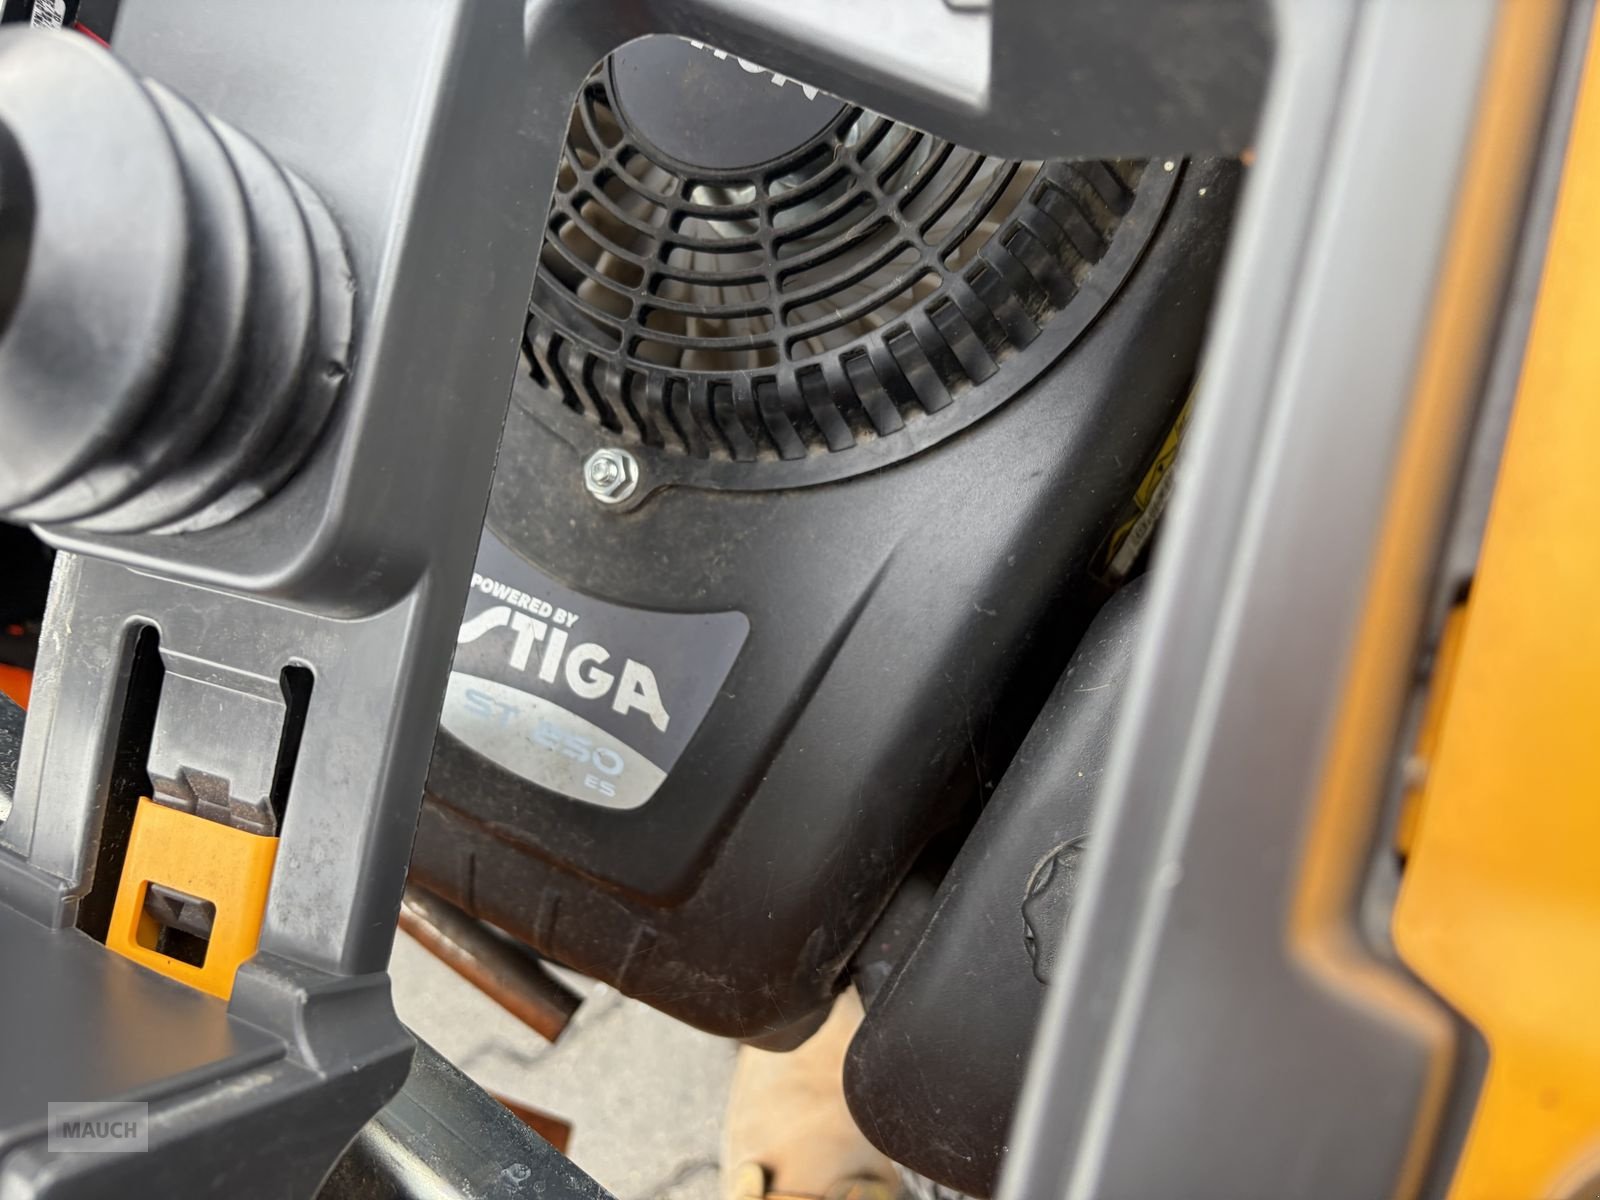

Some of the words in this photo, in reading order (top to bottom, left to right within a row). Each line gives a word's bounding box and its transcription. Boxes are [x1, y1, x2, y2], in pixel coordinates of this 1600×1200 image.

[470, 572, 553, 616] POWERED
[552, 606, 580, 628] BY
[464, 687, 518, 727] ST
[584, 773, 616, 797] ES
